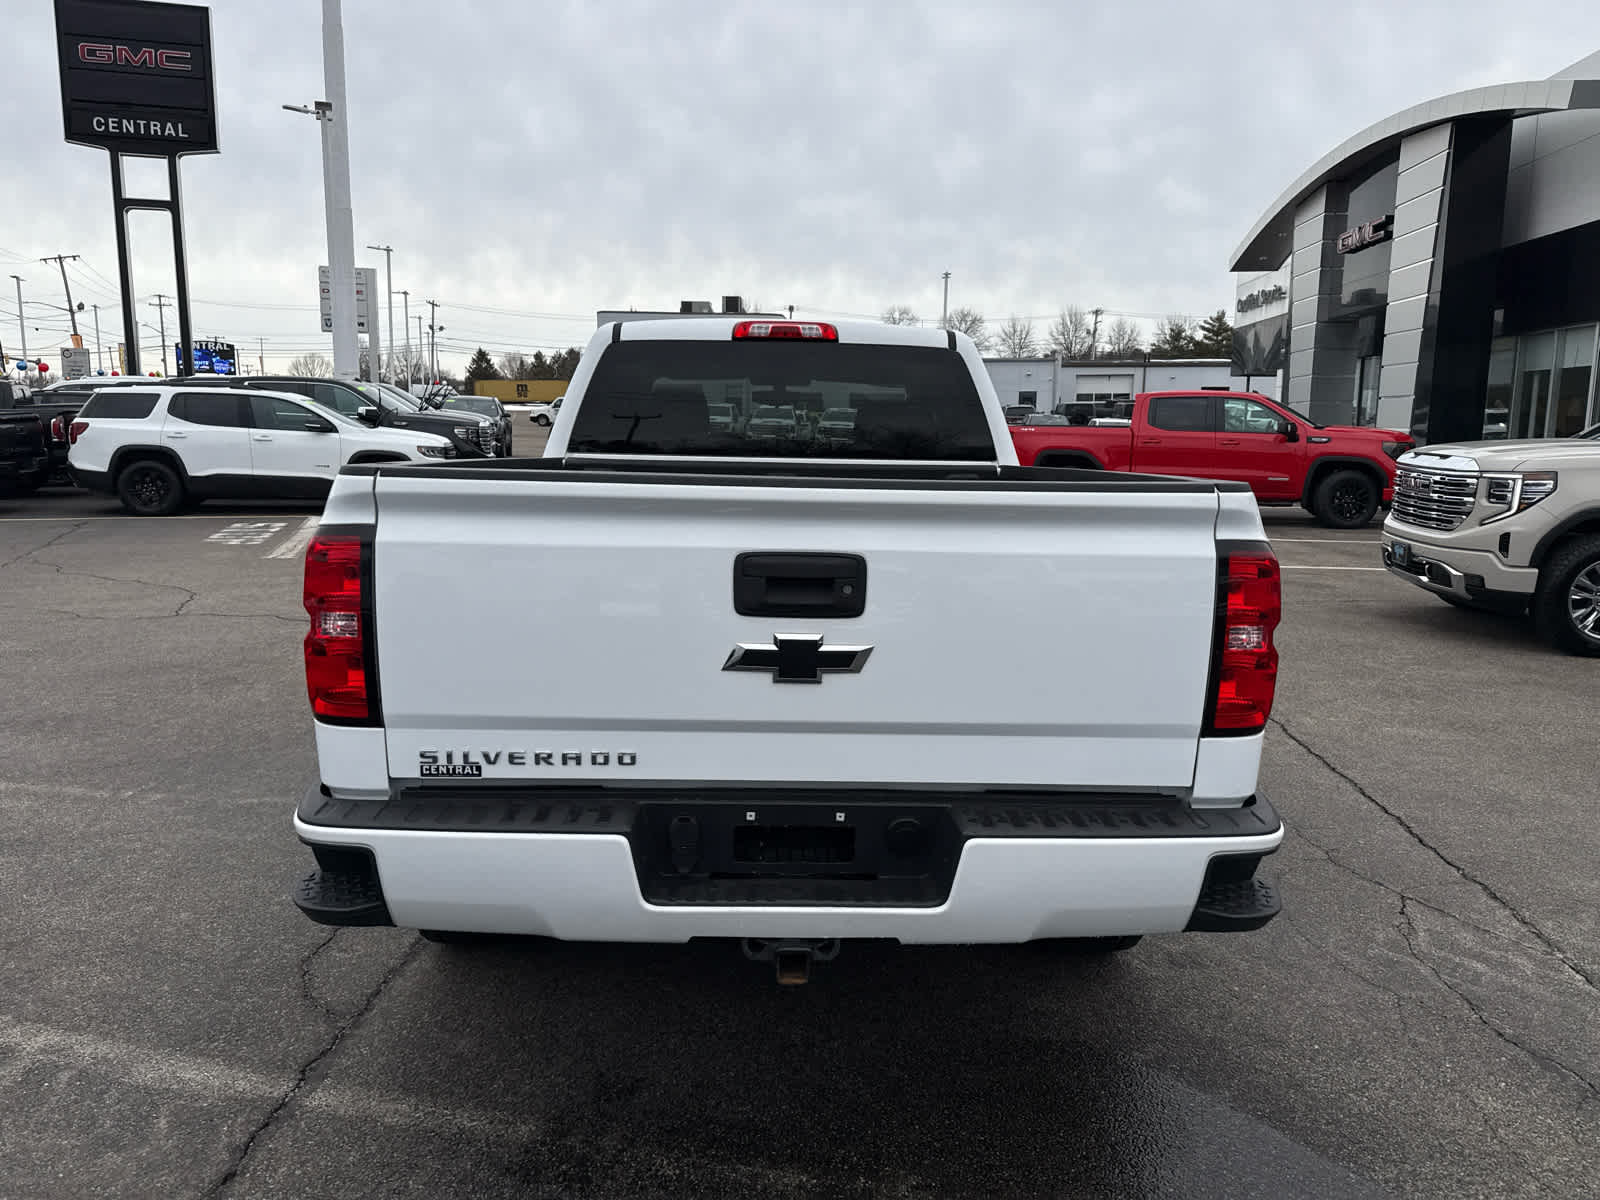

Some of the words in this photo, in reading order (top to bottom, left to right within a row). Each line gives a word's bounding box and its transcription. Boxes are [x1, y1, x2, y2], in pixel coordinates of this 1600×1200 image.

[78, 42, 192, 71] GMC
[93, 117, 189, 138] CENTRAL
[1337, 215, 1385, 254] GMC
[178, 342, 230, 351] NTRAL
[419, 750, 637, 766] SILVERADO
[422, 765, 480, 775] CENTRAL
